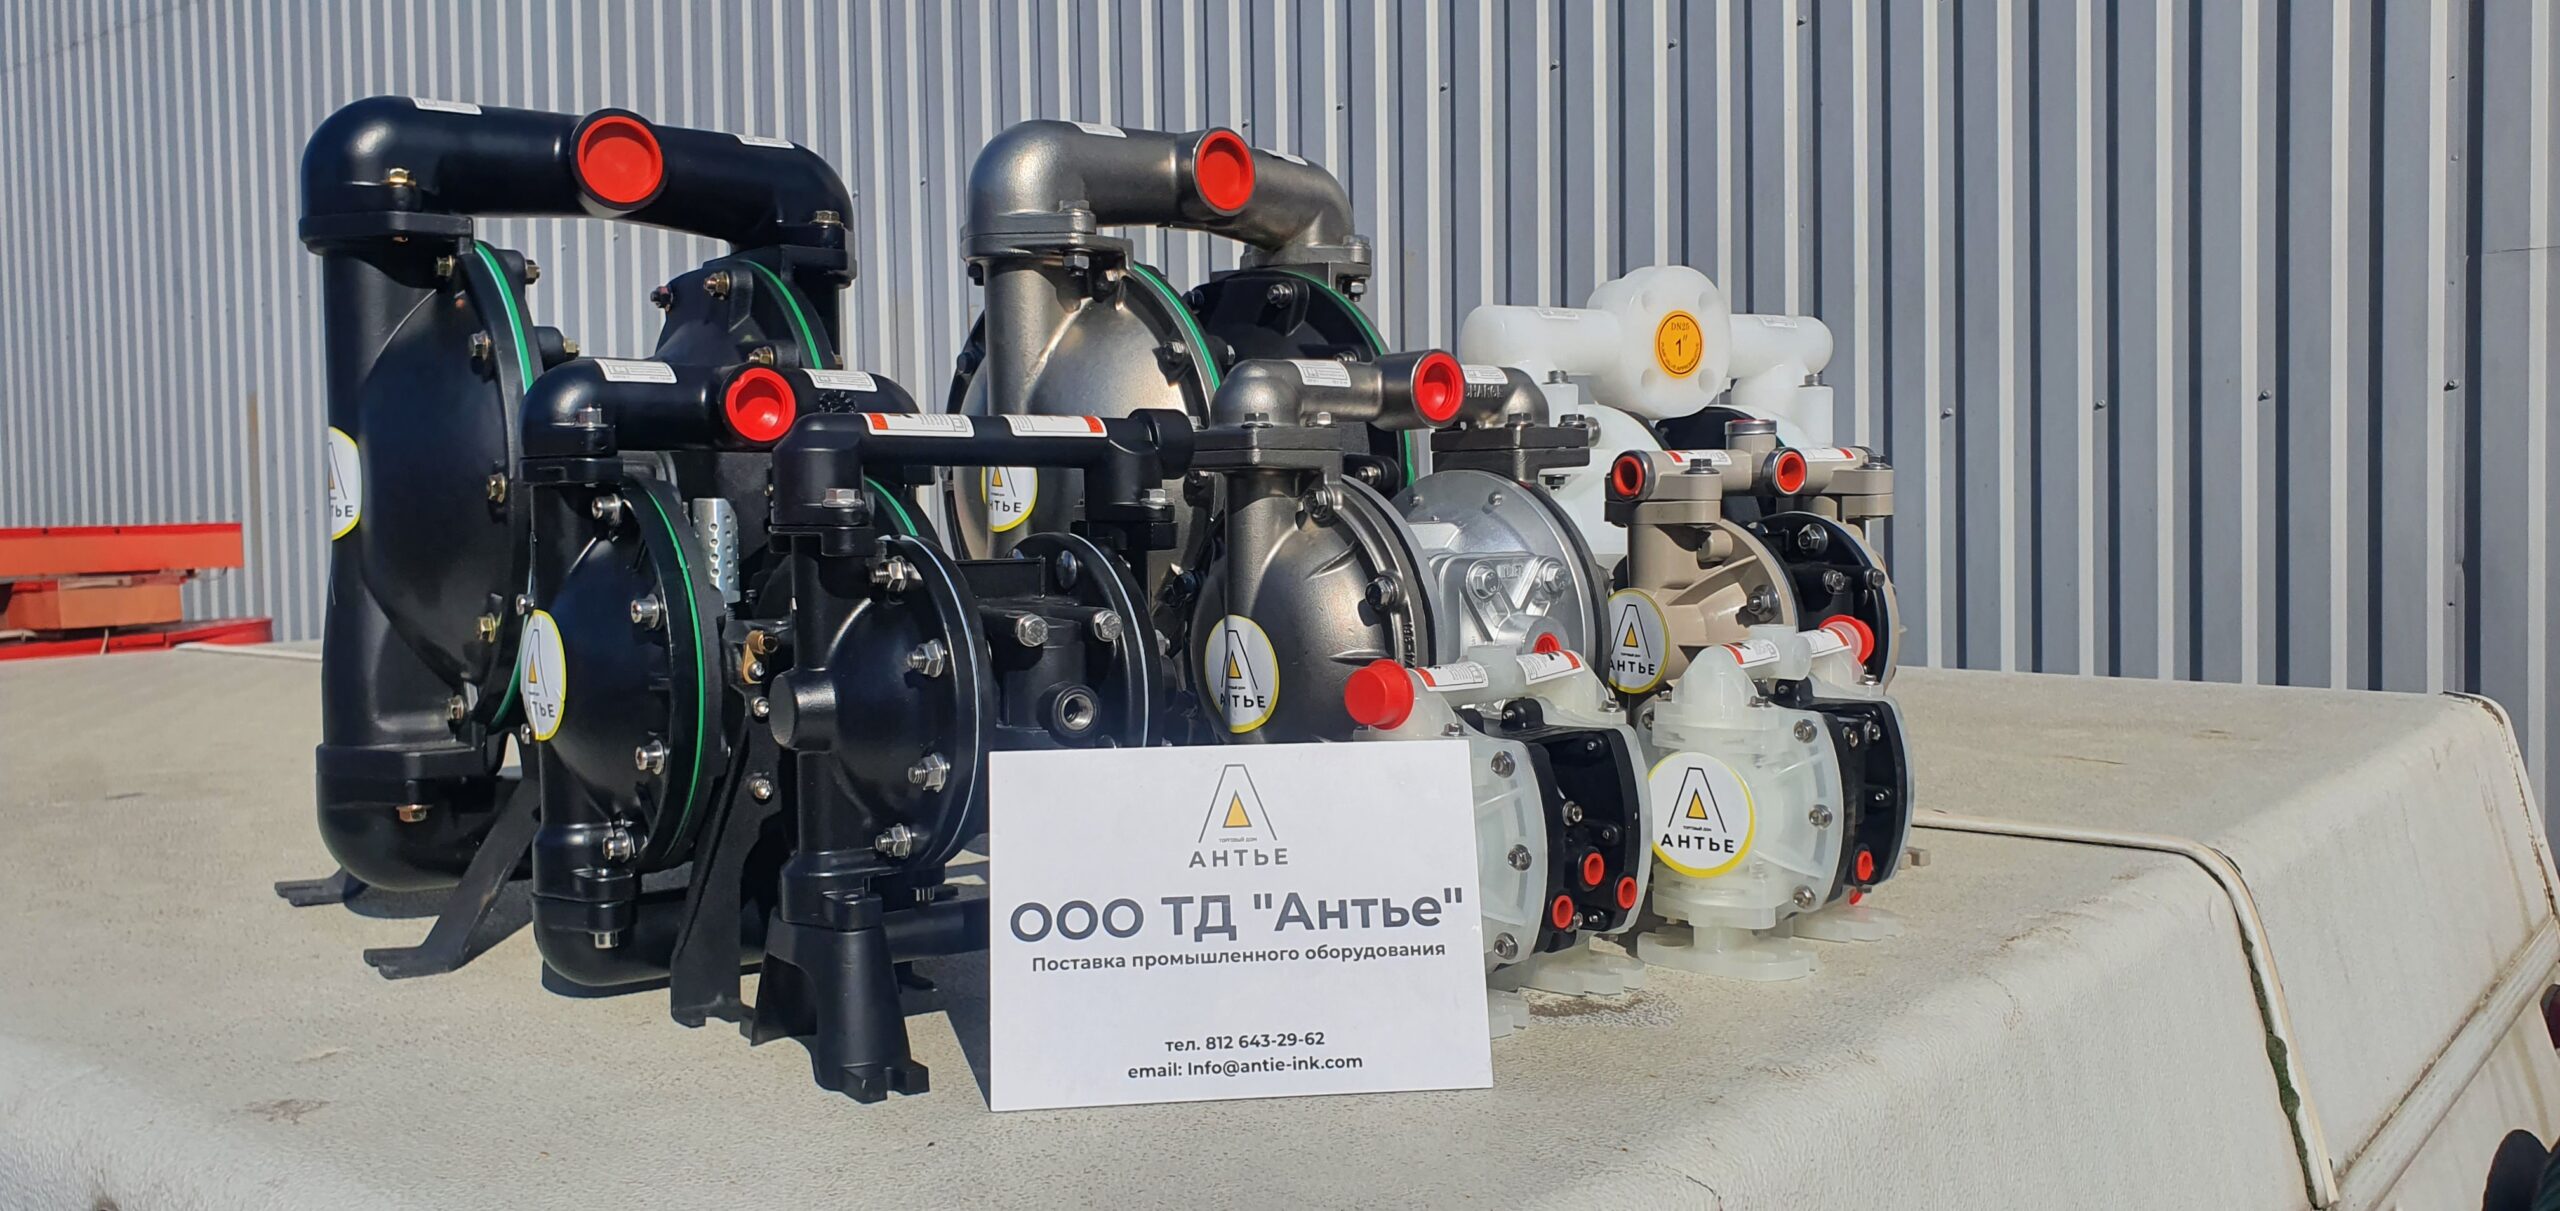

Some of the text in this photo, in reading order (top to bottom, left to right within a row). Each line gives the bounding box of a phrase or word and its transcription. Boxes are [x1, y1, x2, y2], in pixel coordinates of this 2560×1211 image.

[1660, 833, 1735, 854] АНТЬЕ
[1188, 848, 1288, 868] АНТЬЕ
[1010, 887, 1462, 942] ООО ТД "Антье"
[1032, 943, 1446, 972] Поставка промышленного оборудования
[1165, 1032, 1325, 1052] тел. 812 643-29-62
[1128, 1056, 1363, 1079] email: Info@antie-ink.com
